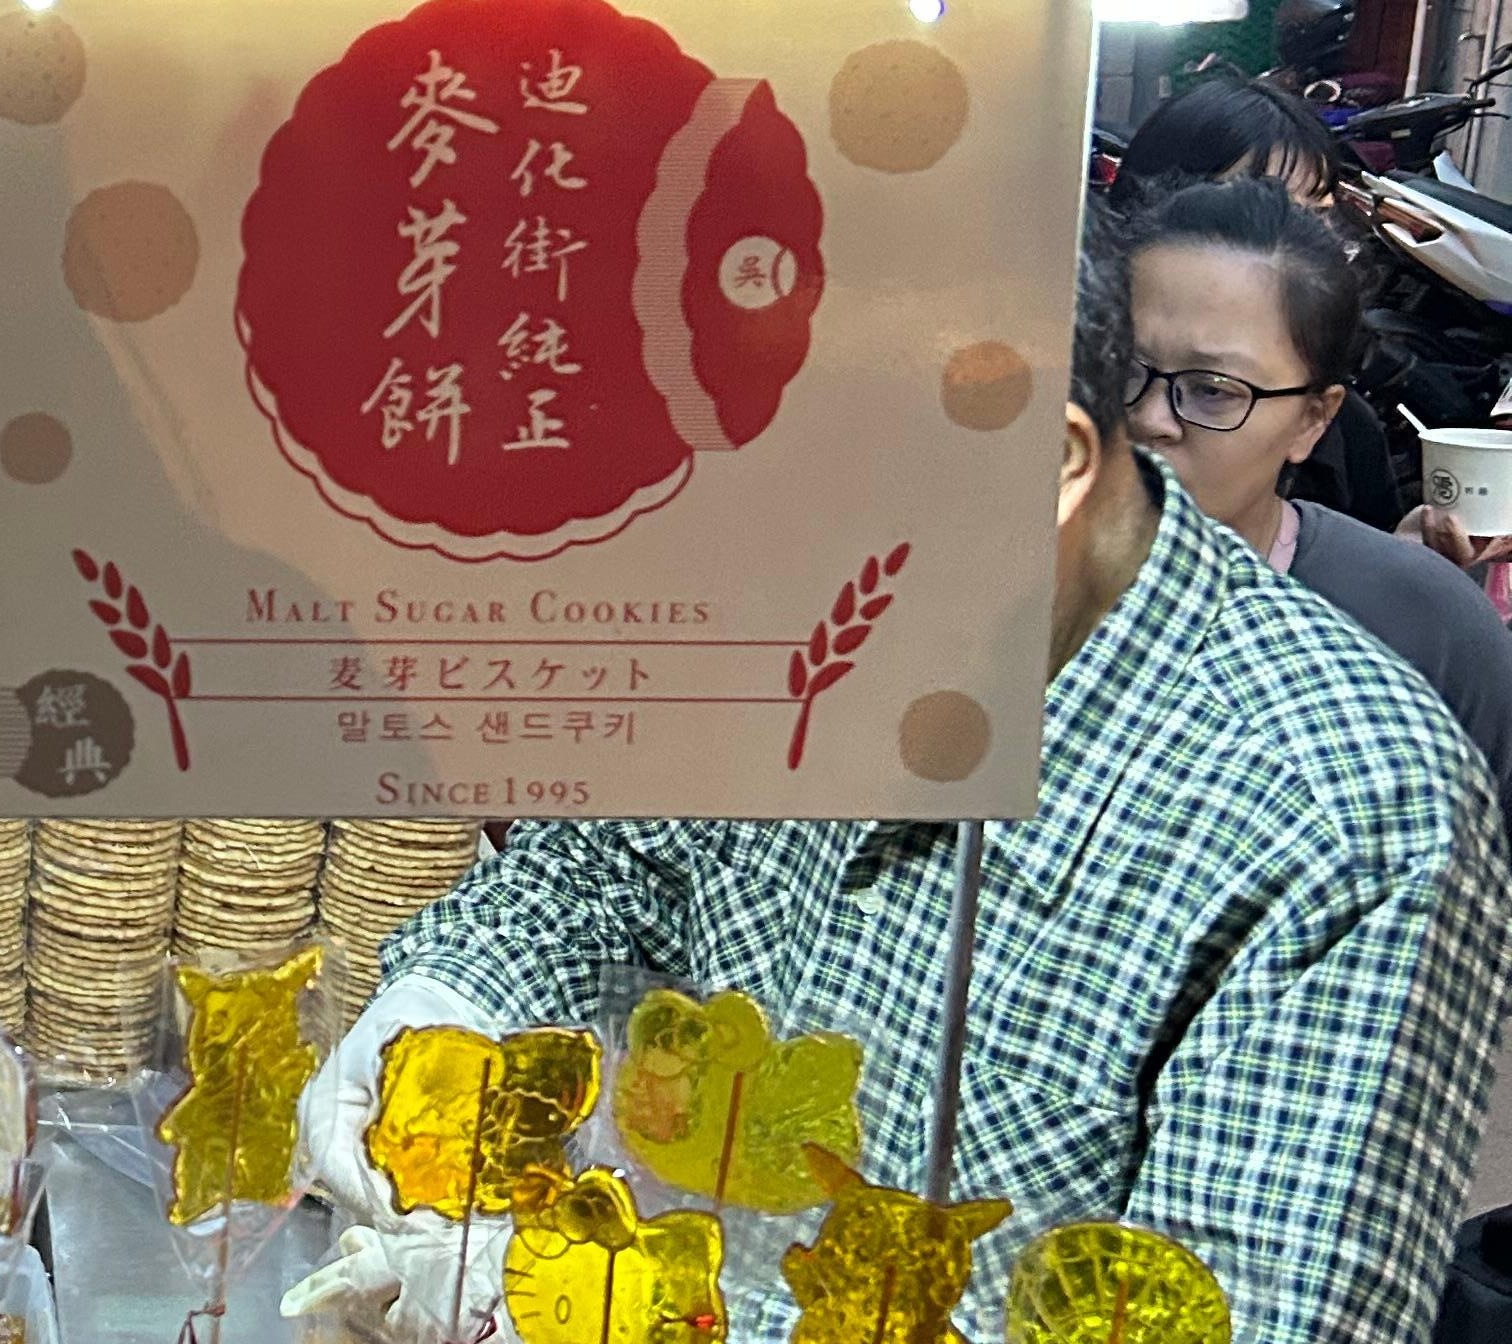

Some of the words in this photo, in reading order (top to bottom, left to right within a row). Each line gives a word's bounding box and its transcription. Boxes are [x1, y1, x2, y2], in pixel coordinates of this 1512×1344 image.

[360, 48, 500, 466] 麥芽餅
[498, 48, 588, 451] 迪化街純正
[245, 588, 355, 623] MALT
[374, 588, 508, 624] SUGAR
[529, 589, 711, 625] COOKIES
[329, 654, 651, 692] 麦芽ビスケット
[36, 683, 113, 787] 經典
[336, 709, 454, 744] 말토스
[476, 709, 637, 745] 샌드쿠키
[375, 771, 489, 807] SINCE
[503, 775, 590, 807] 1995
